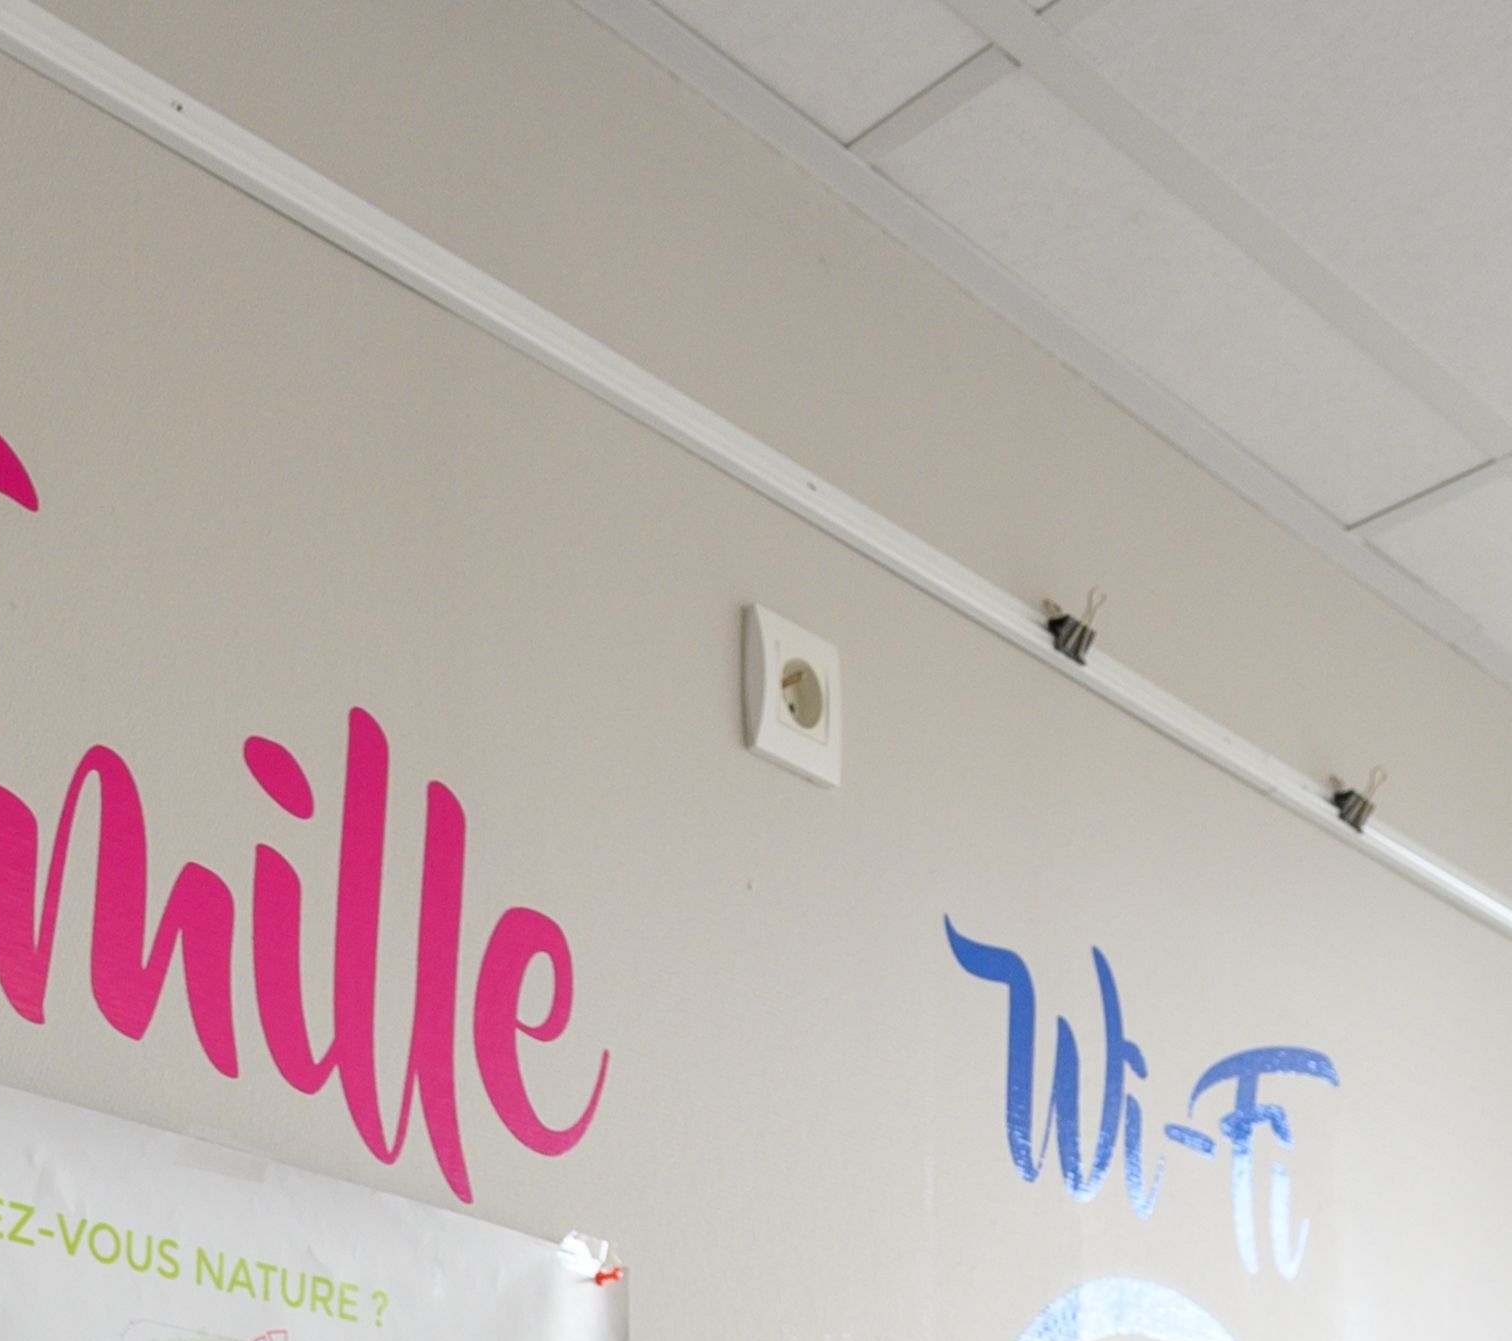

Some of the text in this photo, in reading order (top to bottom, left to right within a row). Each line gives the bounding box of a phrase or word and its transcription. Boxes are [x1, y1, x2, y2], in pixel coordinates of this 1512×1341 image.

[944, 913, 1339, 1280] Wi-Fi
[195, 1252, 361, 1324] NATURE
[371, 1291, 389, 1328] ?
